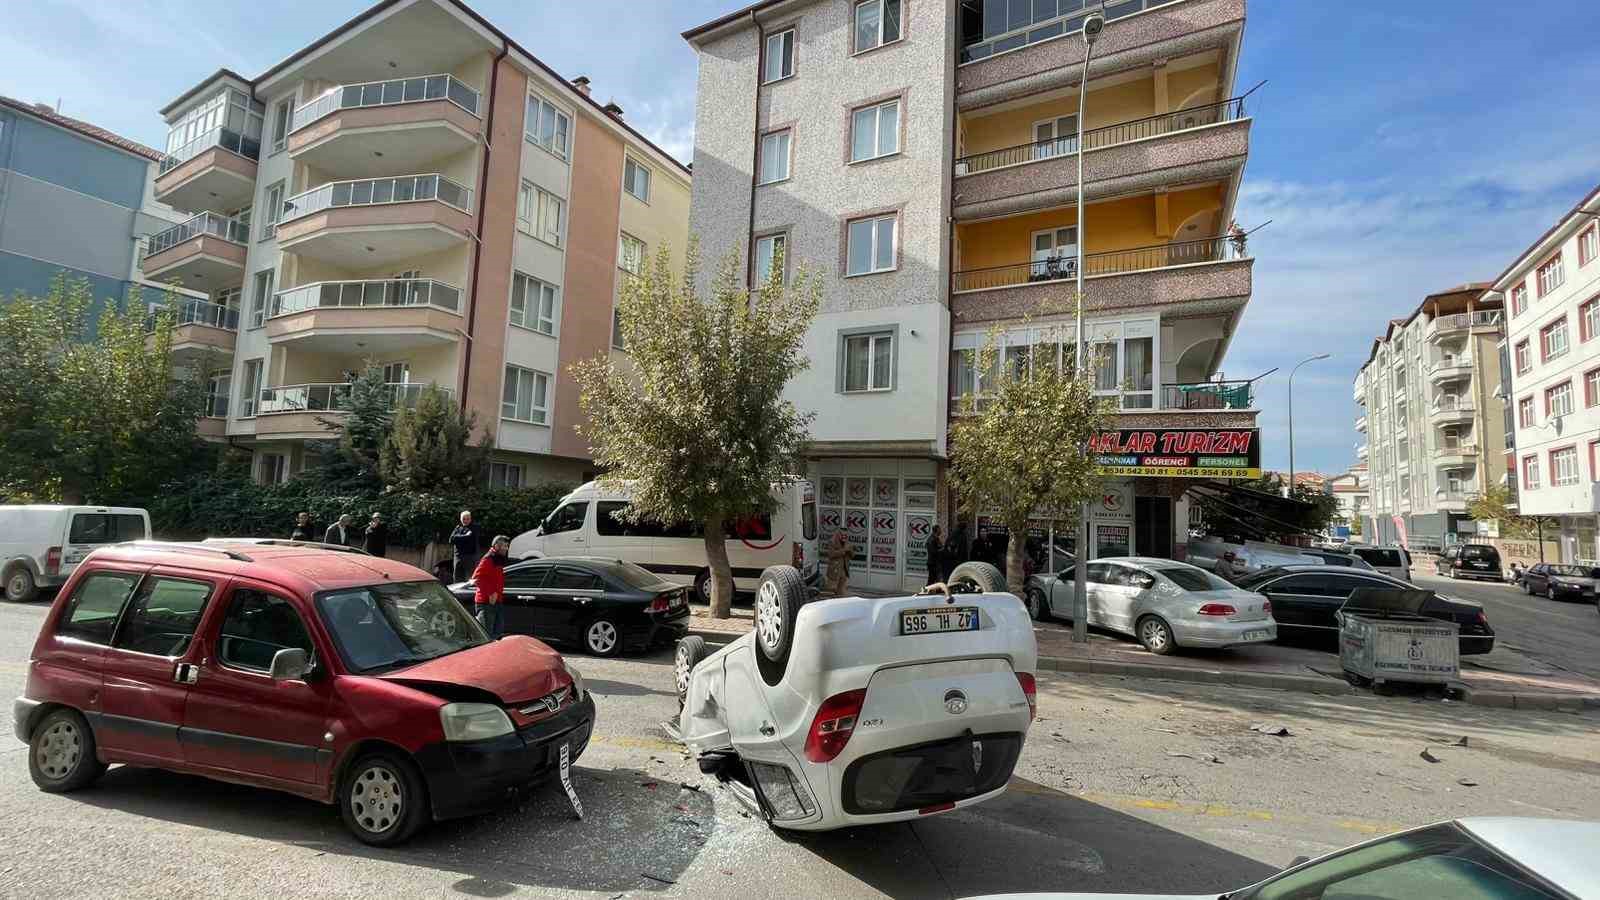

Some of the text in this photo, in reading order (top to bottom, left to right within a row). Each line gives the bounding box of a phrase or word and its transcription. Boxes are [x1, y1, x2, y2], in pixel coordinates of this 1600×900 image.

[1160, 431, 1252, 454] TURİZM
[1199, 457, 1247, 467] PERSONEL
[905, 612, 972, 631] 42 HL 965
